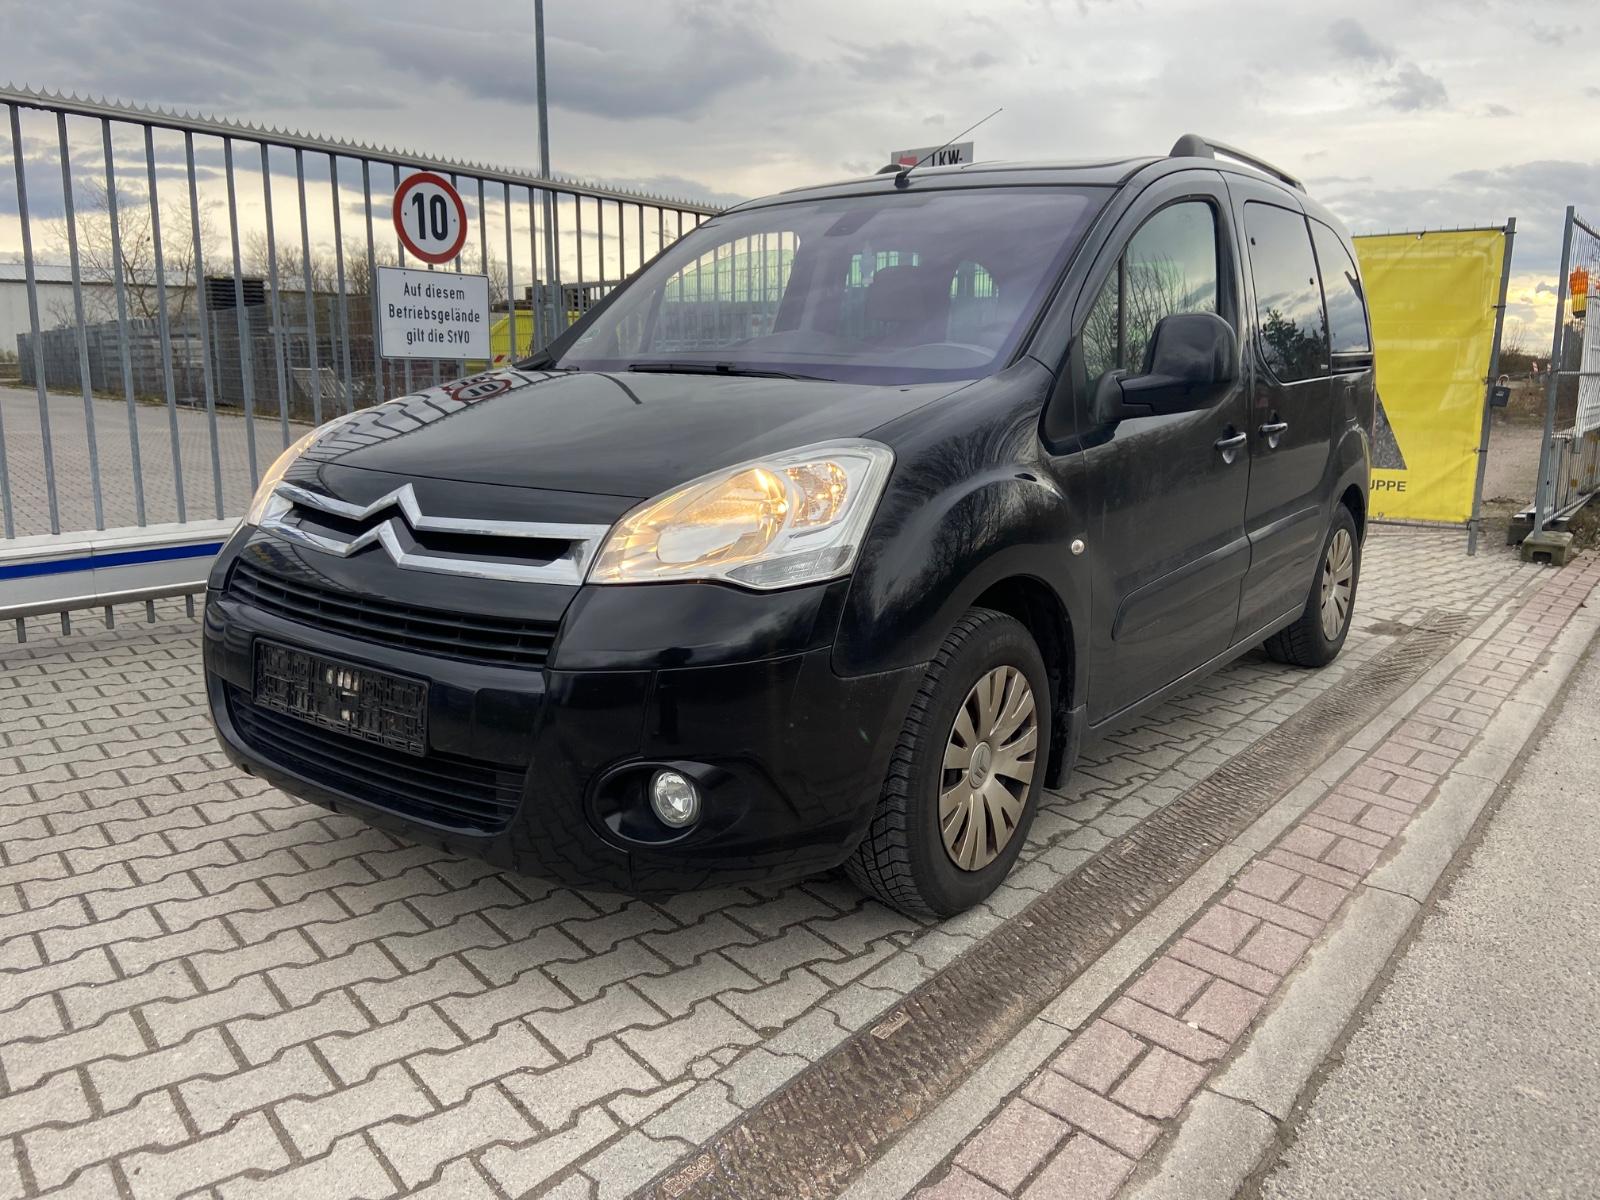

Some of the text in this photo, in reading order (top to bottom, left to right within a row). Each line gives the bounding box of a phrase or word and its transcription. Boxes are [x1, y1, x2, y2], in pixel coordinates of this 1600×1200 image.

[411, 192, 448, 241] 10
[403, 282, 465, 301] Auf diesem
[388, 303, 480, 324] Betriebsgelände
[406, 328, 470, 345] gilt die StVO
